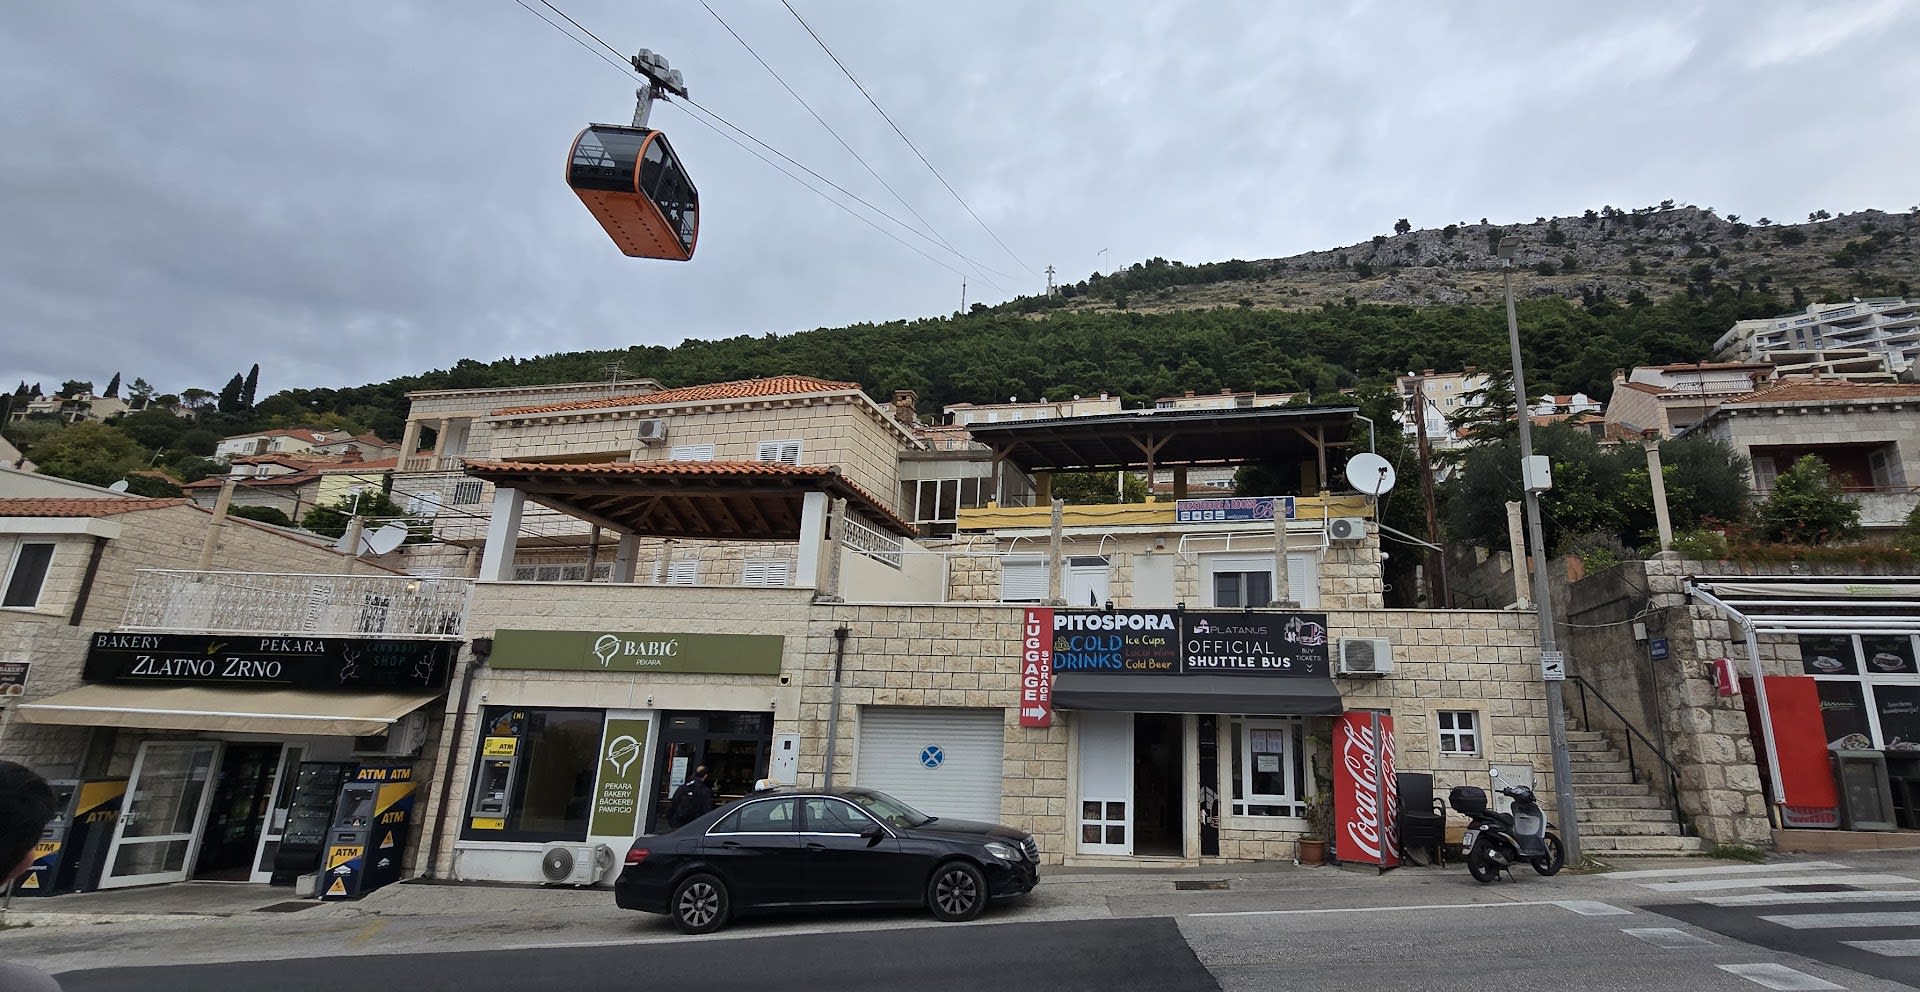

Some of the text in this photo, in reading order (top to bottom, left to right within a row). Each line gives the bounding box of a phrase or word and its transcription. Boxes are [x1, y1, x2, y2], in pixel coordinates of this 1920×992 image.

[1053, 614, 1175, 631] PITOSPORA
[1210, 626, 1268, 635] PLATANUS
[97, 636, 325, 652] BAKERY PEKARA
[624, 638, 678, 656] BABIĆ
[1070, 635, 1123, 651] COLD
[1125, 635, 1166, 648] Ice Cups
[1188, 640, 1275, 654] OFFICIAL
[374, 655, 406, 667] SHOP
[1024, 612, 1040, 701] LUGGAGE
[1053, 653, 1123, 669] DRINKS
[1125, 658, 1172, 669] Cold Beer
[1188, 656, 1291, 668] SHUTTLE BUS
[131, 655, 282, 678] ZLATNO ZRNO
[1040, 650, 1049, 702] STORAGE
[357, 768, 411, 780] ATM ATM
[604, 782, 632, 790] PEKARA
[1343, 718, 1381, 858] Coca-Cola
[603, 790, 632, 798] BAKERY
[86, 810, 121, 823] ATM
[381, 811, 405, 825] ATM
[335, 848, 358, 857] ATM
